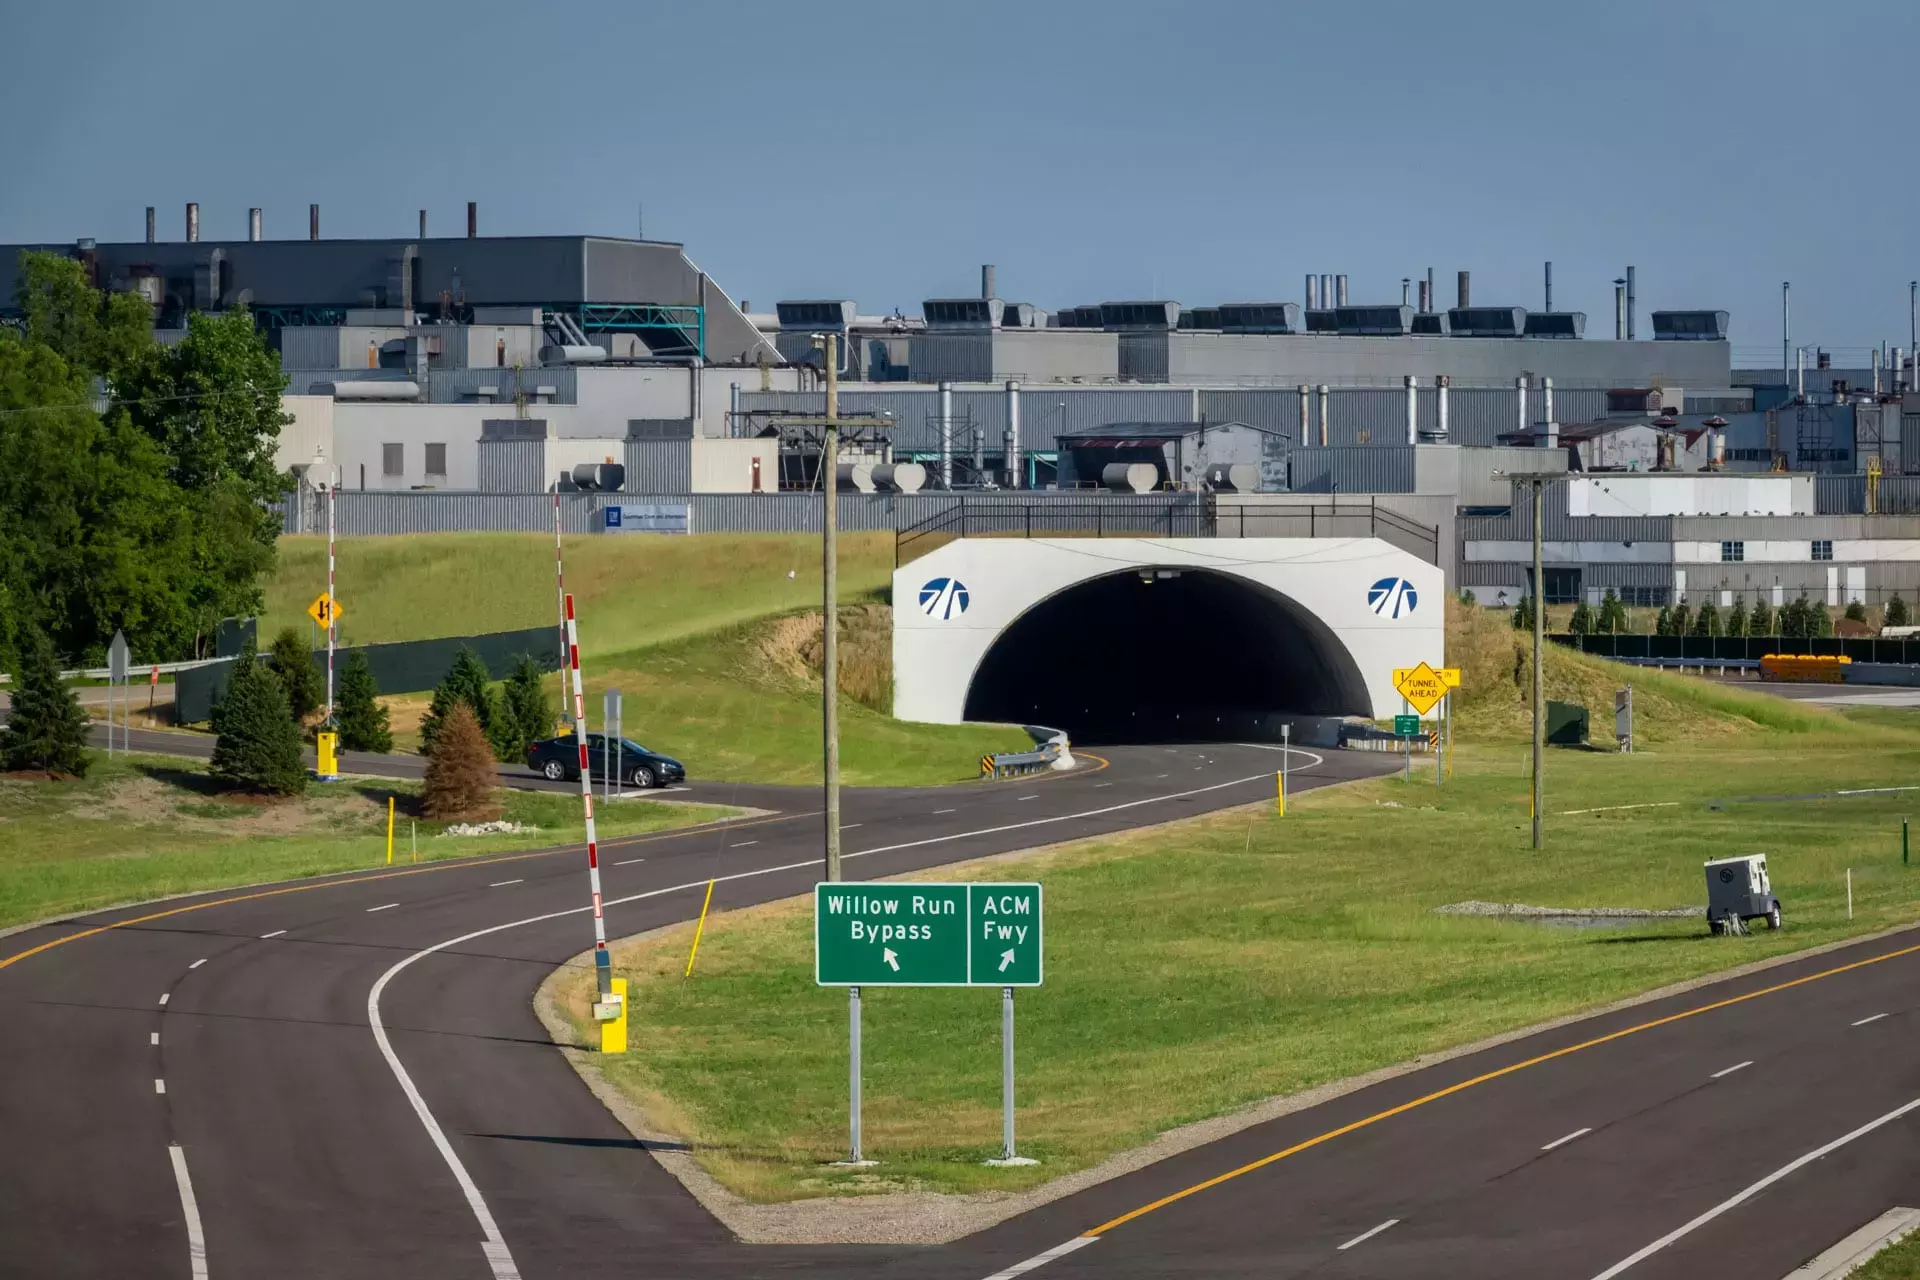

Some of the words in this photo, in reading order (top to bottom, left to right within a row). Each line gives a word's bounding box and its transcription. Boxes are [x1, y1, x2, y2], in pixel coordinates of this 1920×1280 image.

[1408, 679, 1437, 688] TUNNEL
[1409, 689, 1438, 698] AHEAD
[828, 895, 899, 915] Willow
[912, 895, 956, 915] Run
[983, 895, 1030, 915] ACM
[851, 920, 932, 944] Bypass
[984, 921, 1028, 945] Fwy
